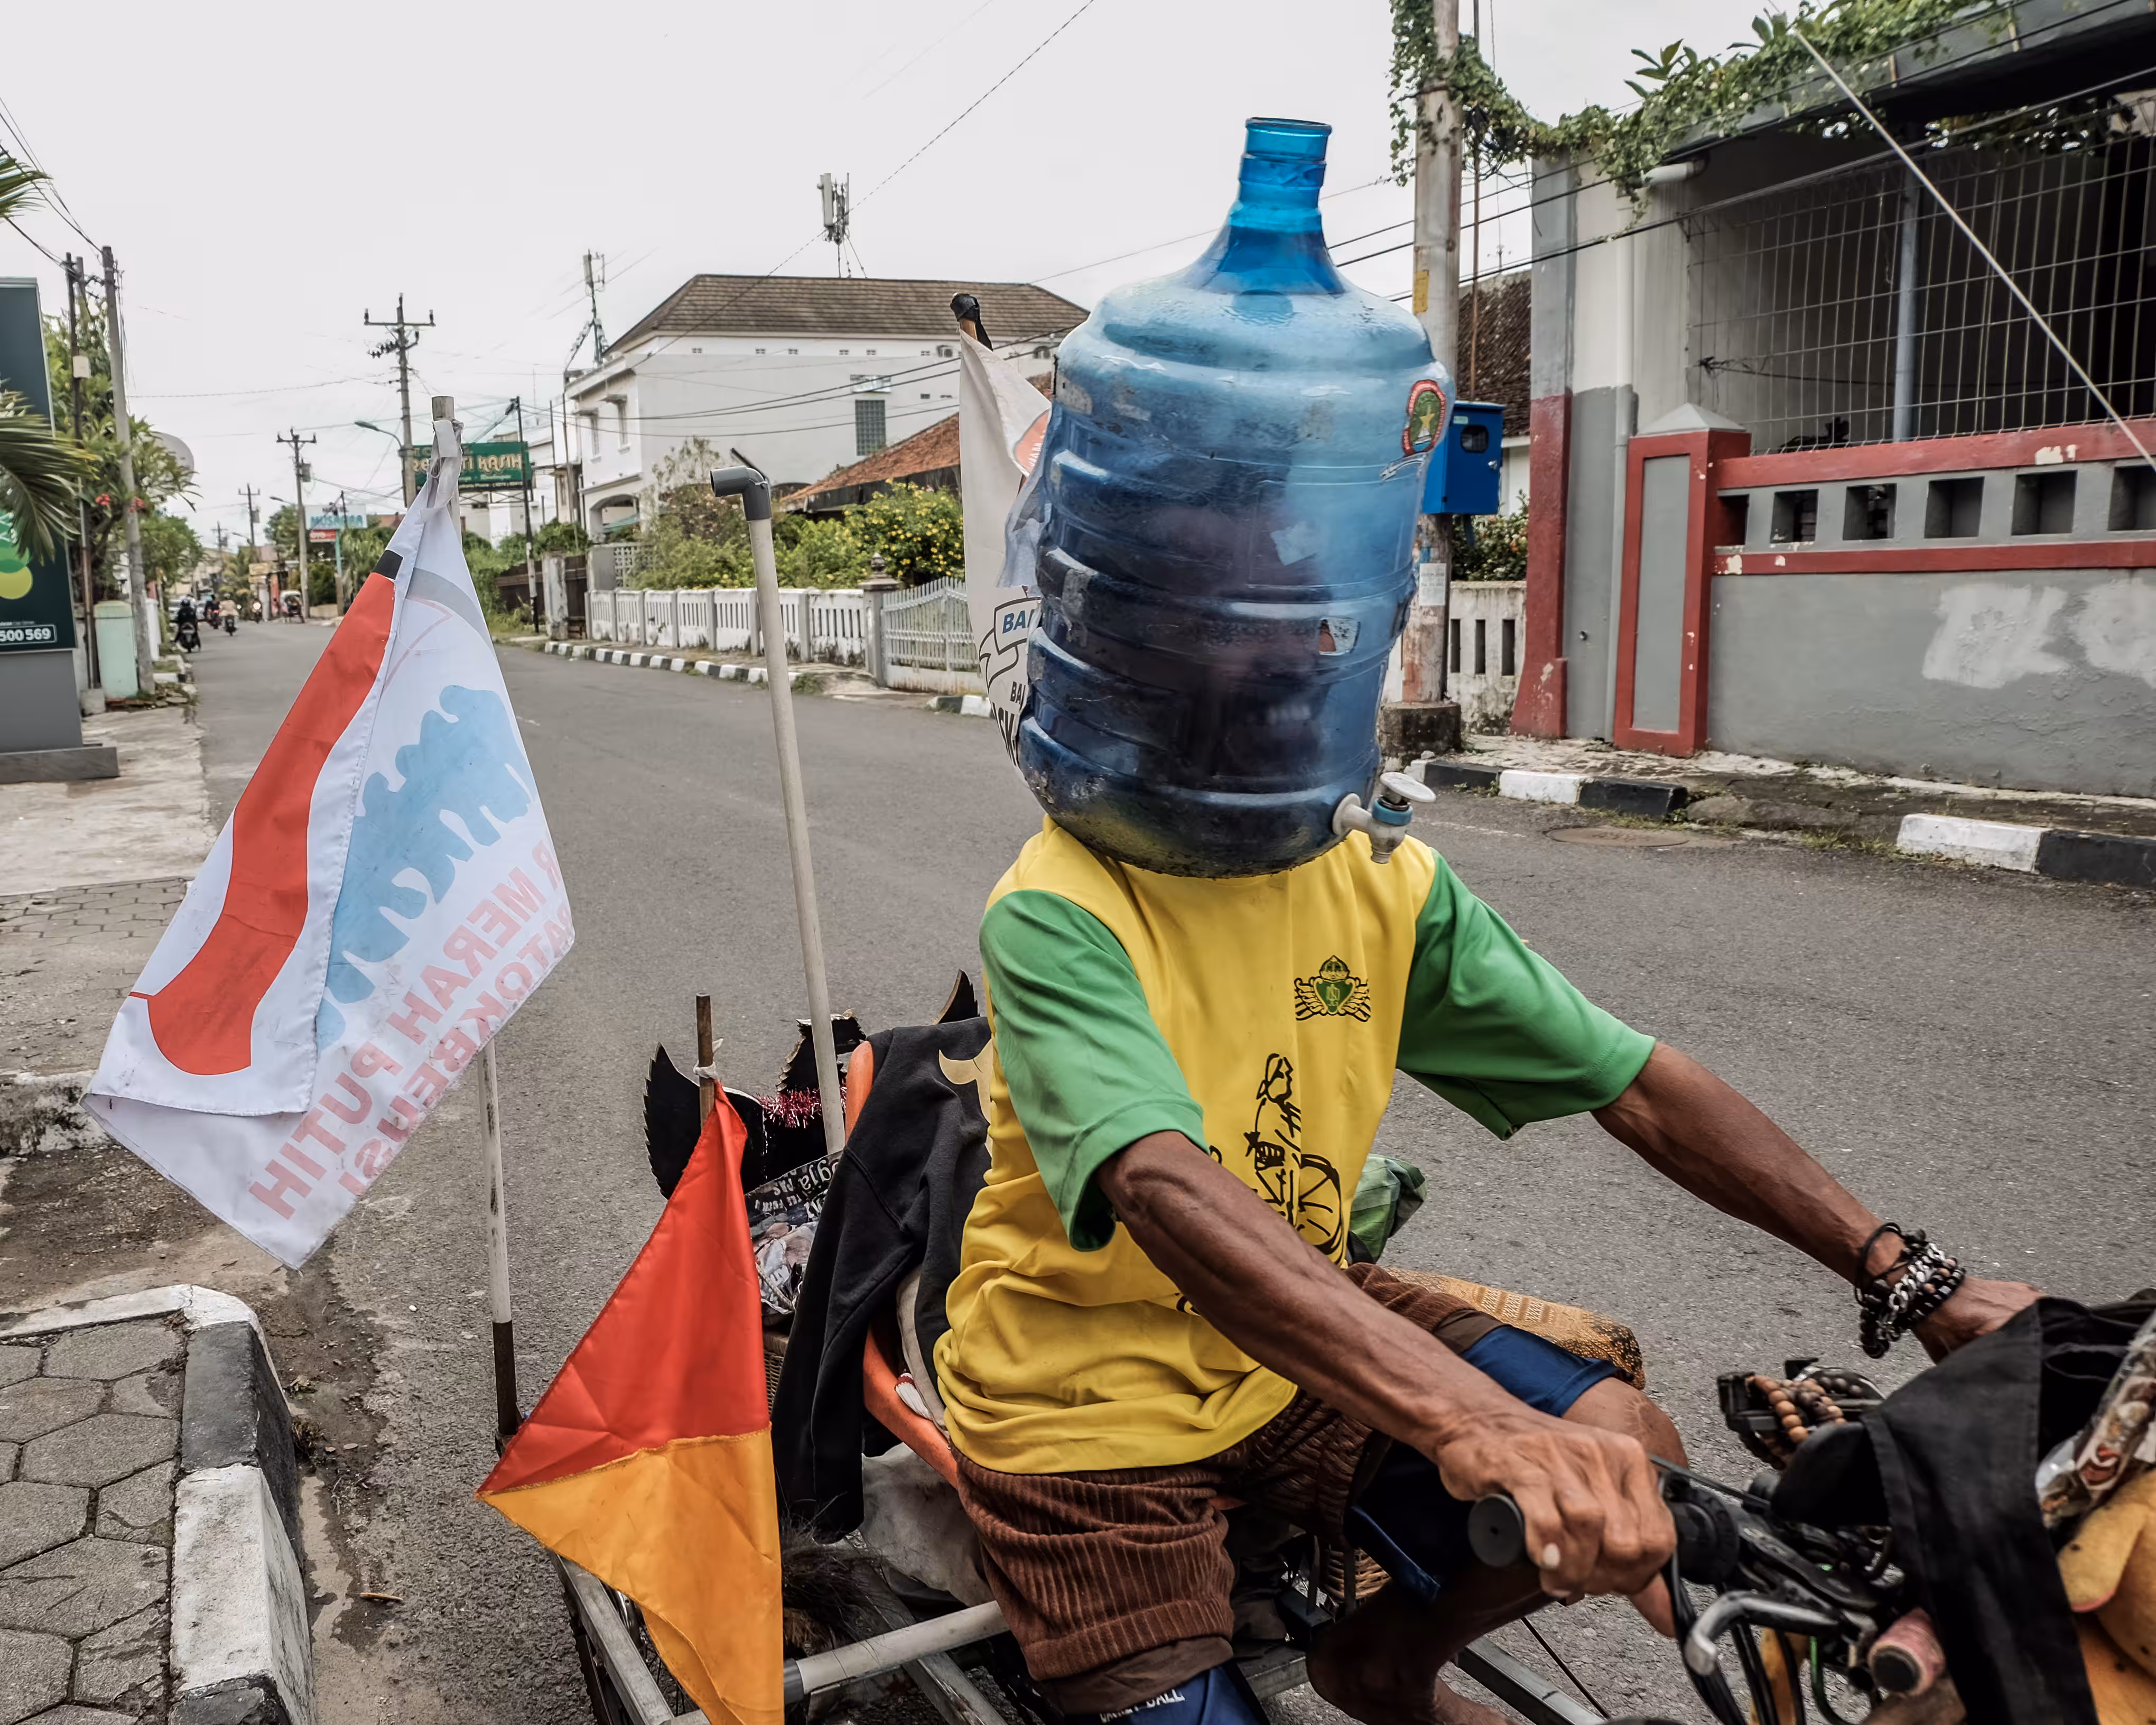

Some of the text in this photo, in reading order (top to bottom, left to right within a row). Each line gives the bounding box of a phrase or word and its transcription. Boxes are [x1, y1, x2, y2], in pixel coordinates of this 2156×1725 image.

[1002, 609, 1035, 634] BA
[0, 628, 51, 642] 500 569
